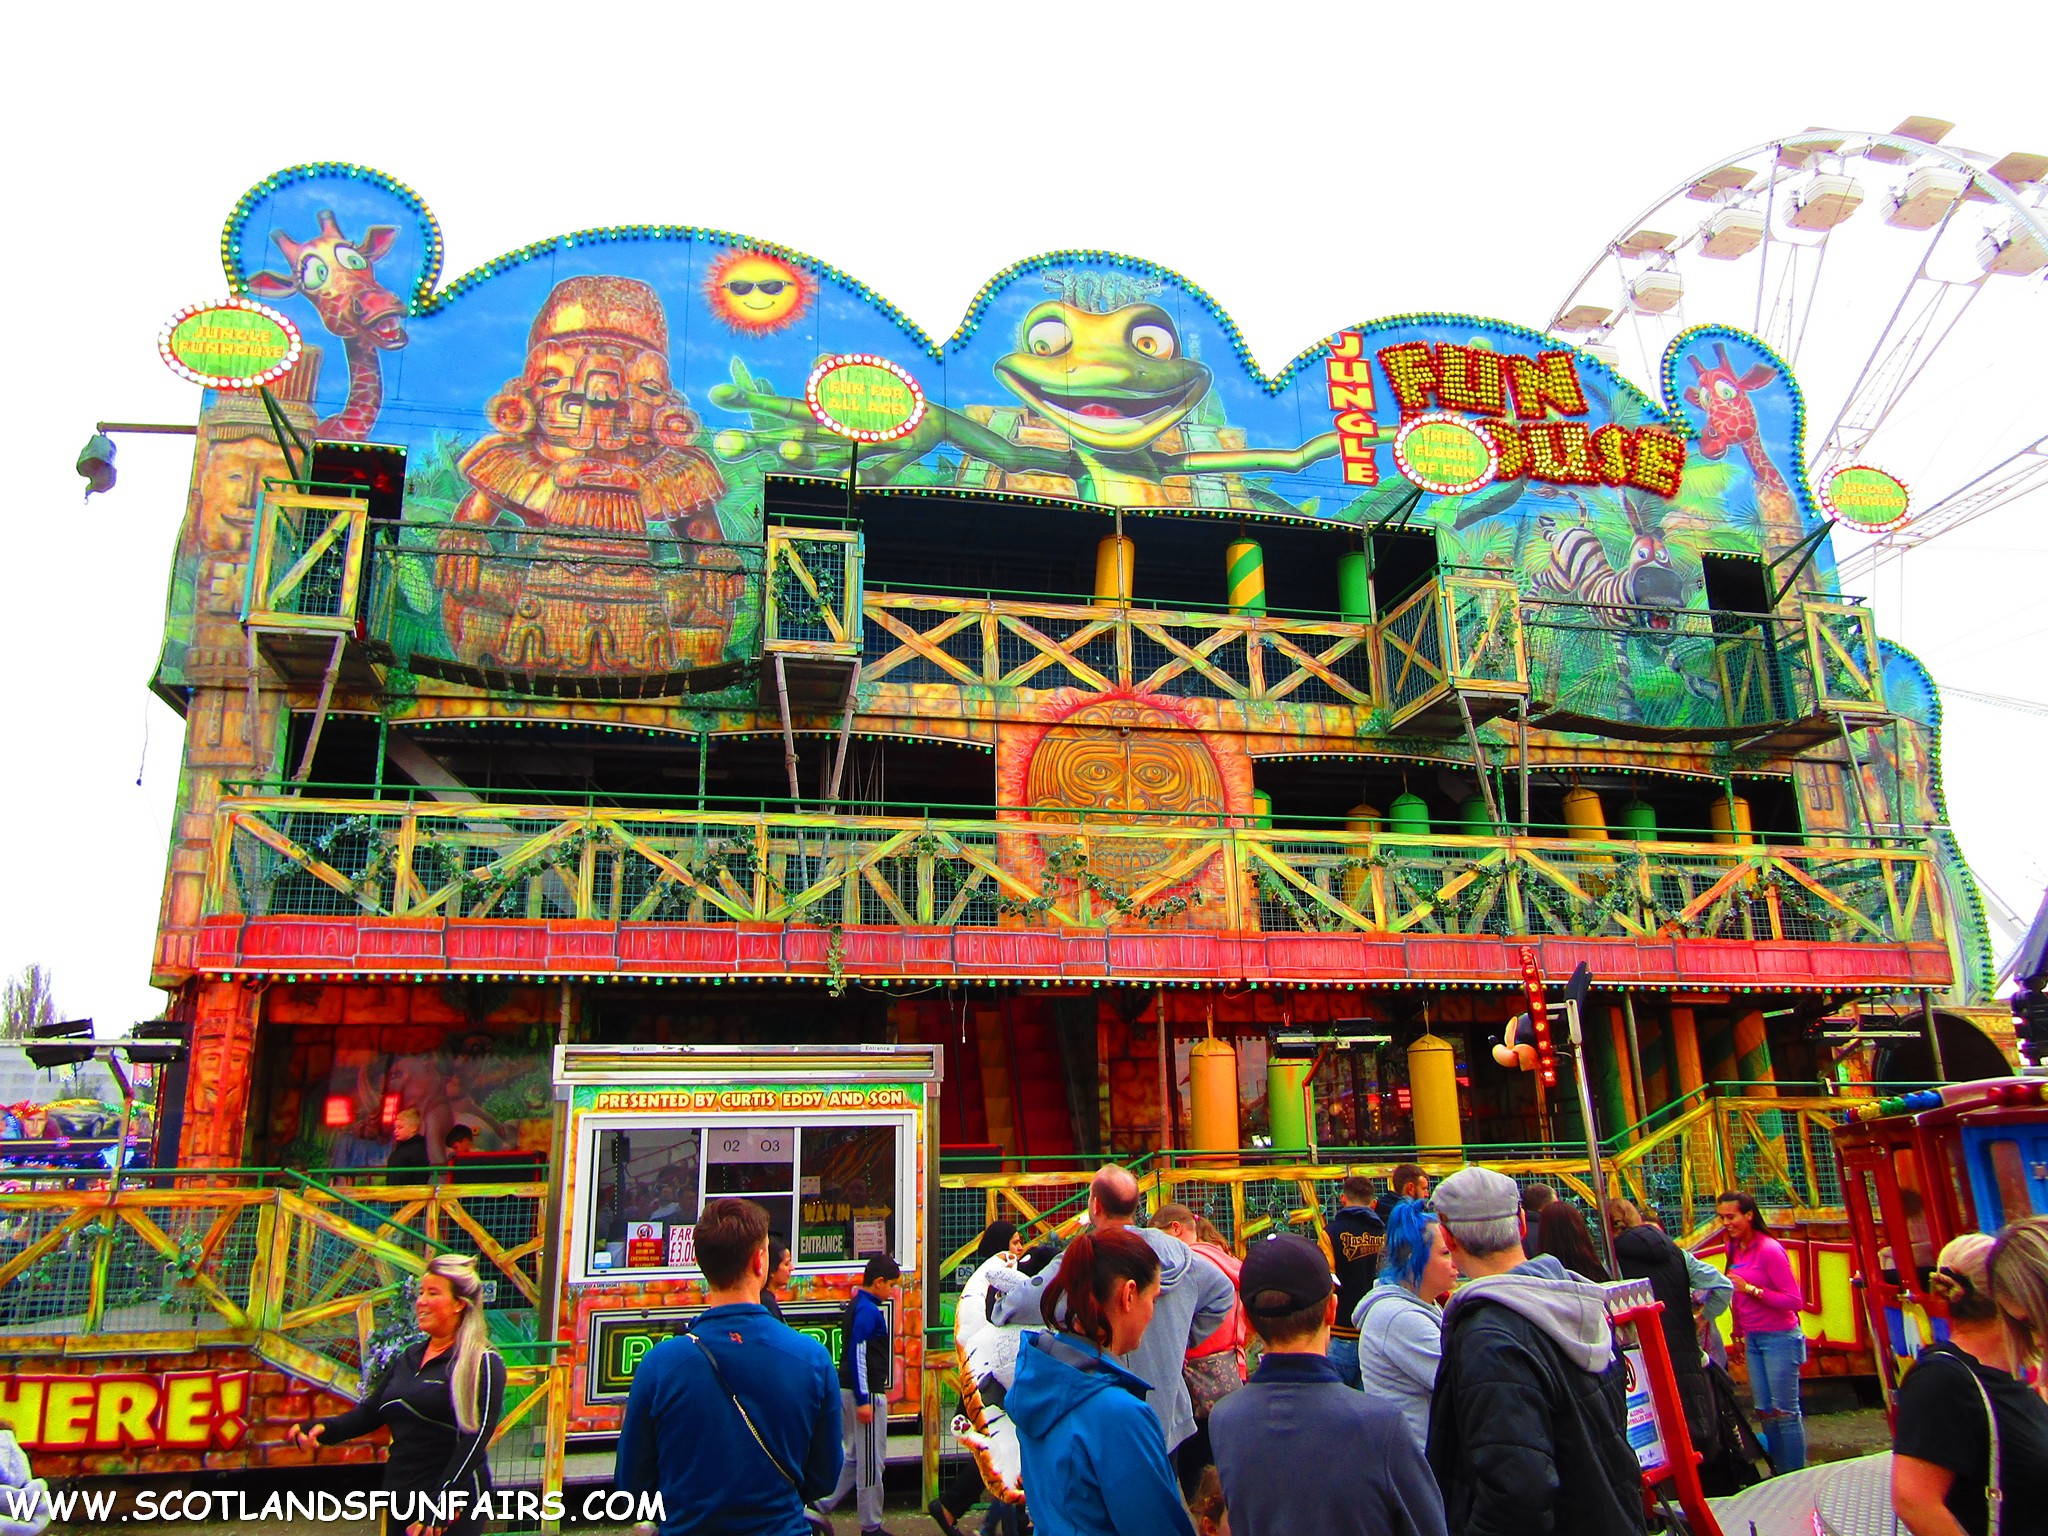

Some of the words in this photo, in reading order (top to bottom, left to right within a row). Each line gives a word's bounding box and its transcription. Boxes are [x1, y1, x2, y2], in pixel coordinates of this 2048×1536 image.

[193, 327, 272, 342] JUNGLE
[178, 340, 285, 358] FUNHOUSE
[1377, 340, 1591, 420] FUN
[828, 381, 866, 396] FUN
[870, 384, 905, 399] FOR
[828, 397, 861, 412] ALL
[867, 401, 908, 416] AGES
[1326, 331, 1379, 486] JUNGLE
[1421, 429, 1472, 445] THREE
[1401, 408, 1688, 499] OUSE
[1413, 444, 1477, 462] FLOORS
[1416, 461, 1438, 474] OF
[1442, 464, 1477, 478] FUN
[1841, 483, 1893, 495] JUNGLE
[1832, 494, 1905, 507] FUNHOUSE
[598, 1093, 690, 1109] PRESENTED
[693, 1092, 717, 1108] BY
[720, 1092, 777, 1107] CURTIS
[782, 1091, 824, 1107] EDDY
[828, 1091, 864, 1106] AND
[868, 1090, 904, 1106] SON
[803, 1204, 834, 1223] WAY
[836, 1204, 851, 1222] IN
[670, 1227, 697, 1241] FAR
[800, 1235, 843, 1254] ENTRANCE
[0, 1373, 247, 1448] HERE!
